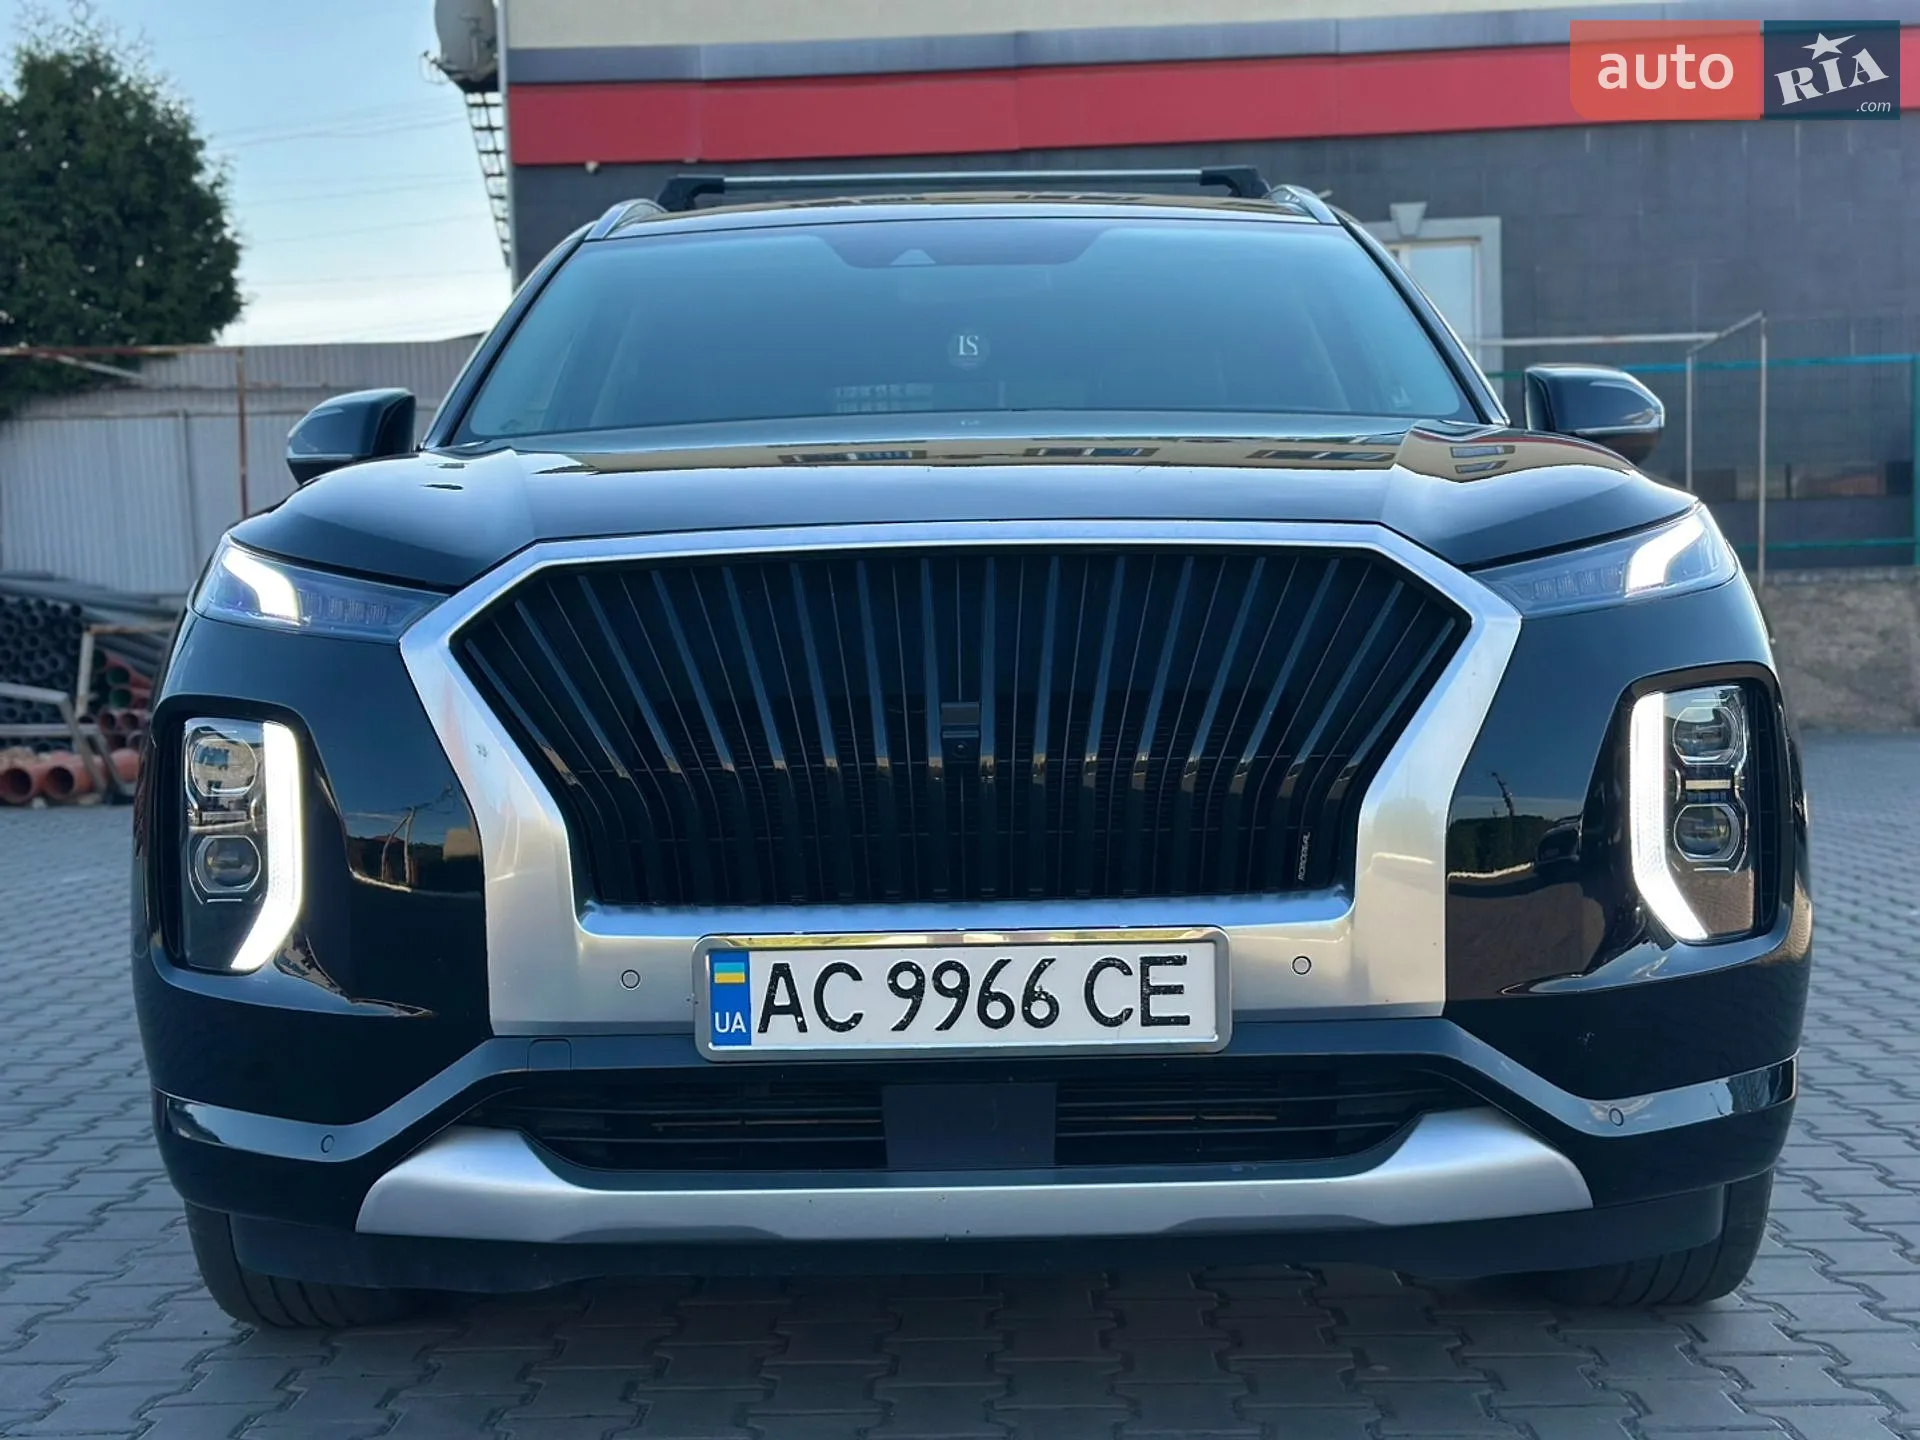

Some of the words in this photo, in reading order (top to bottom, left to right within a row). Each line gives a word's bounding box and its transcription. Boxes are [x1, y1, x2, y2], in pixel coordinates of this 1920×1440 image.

[757, 961, 863, 1034] AC
[886, 957, 1060, 1032] 9966
[1083, 954, 1192, 1029] CE
[715, 1016, 747, 1034] UA
